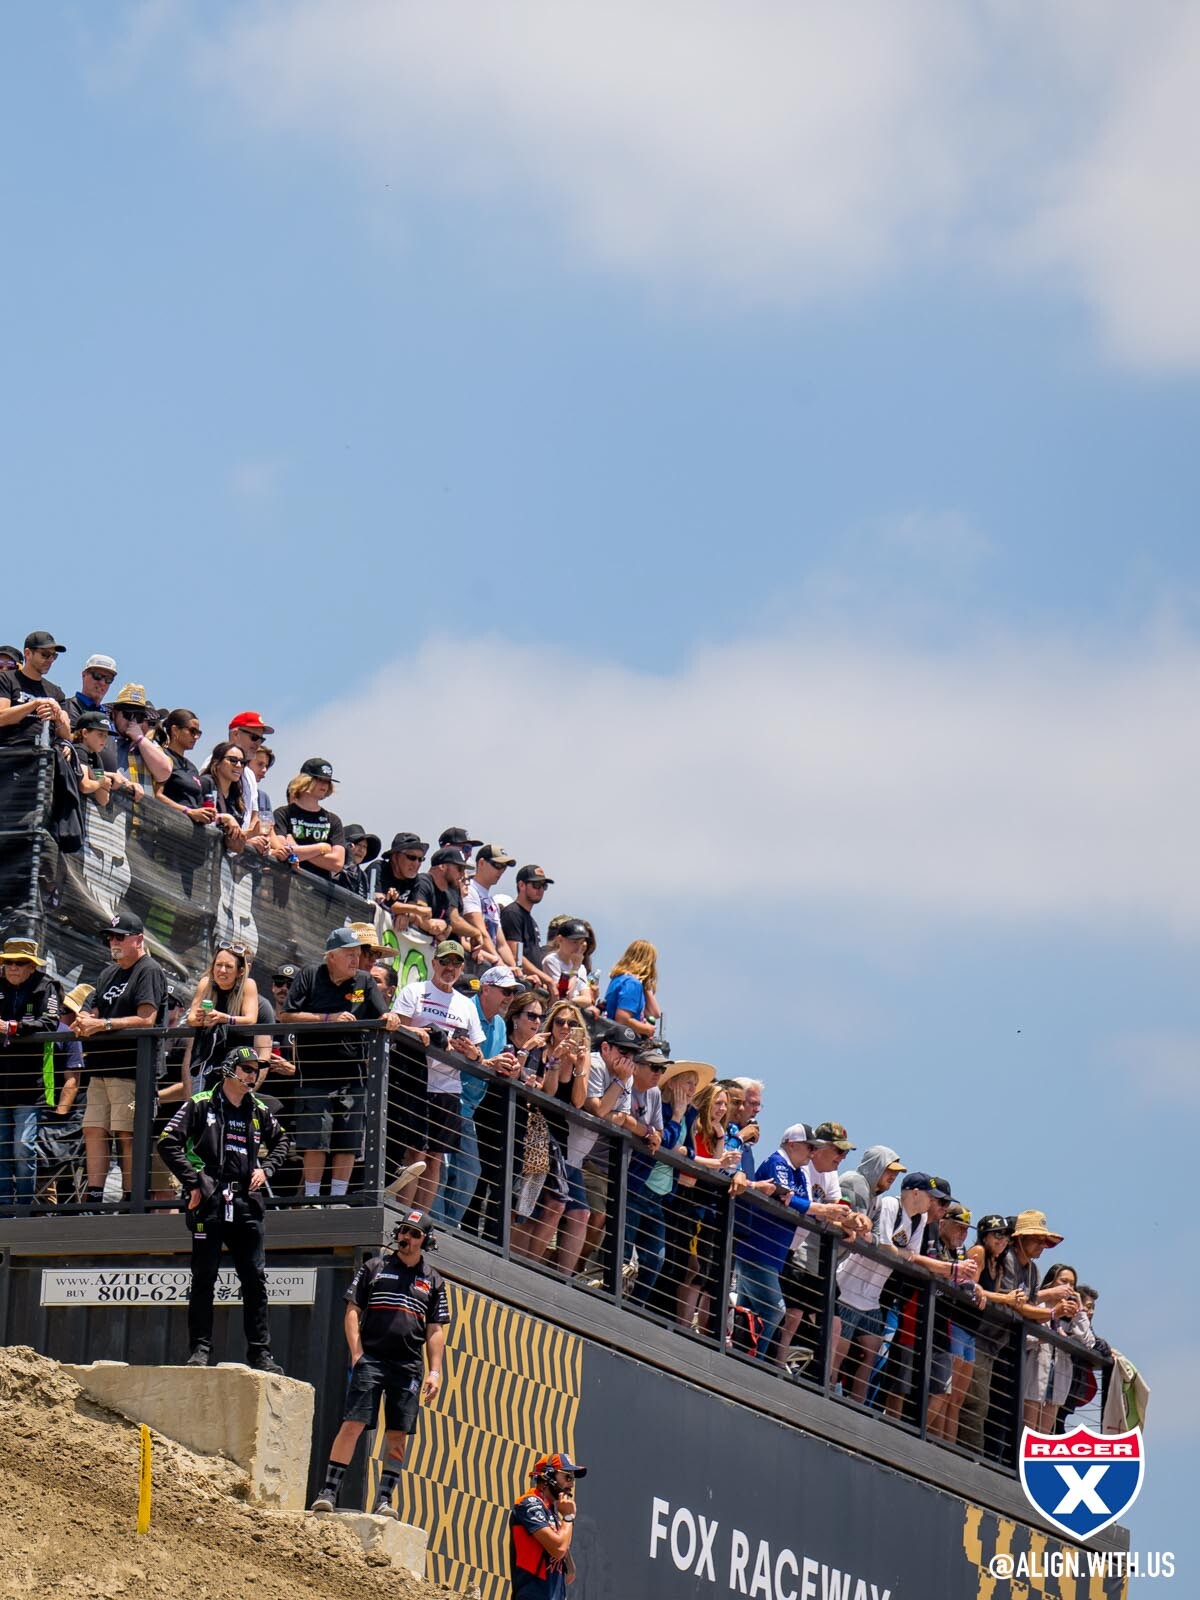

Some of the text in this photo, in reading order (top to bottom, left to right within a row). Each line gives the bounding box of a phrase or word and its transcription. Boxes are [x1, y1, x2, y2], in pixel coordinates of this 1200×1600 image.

[422, 1006, 463, 1023] HONDA
[66, 1289, 87, 1298] BUY
[650, 1496, 892, 1600] FOX RACEW
